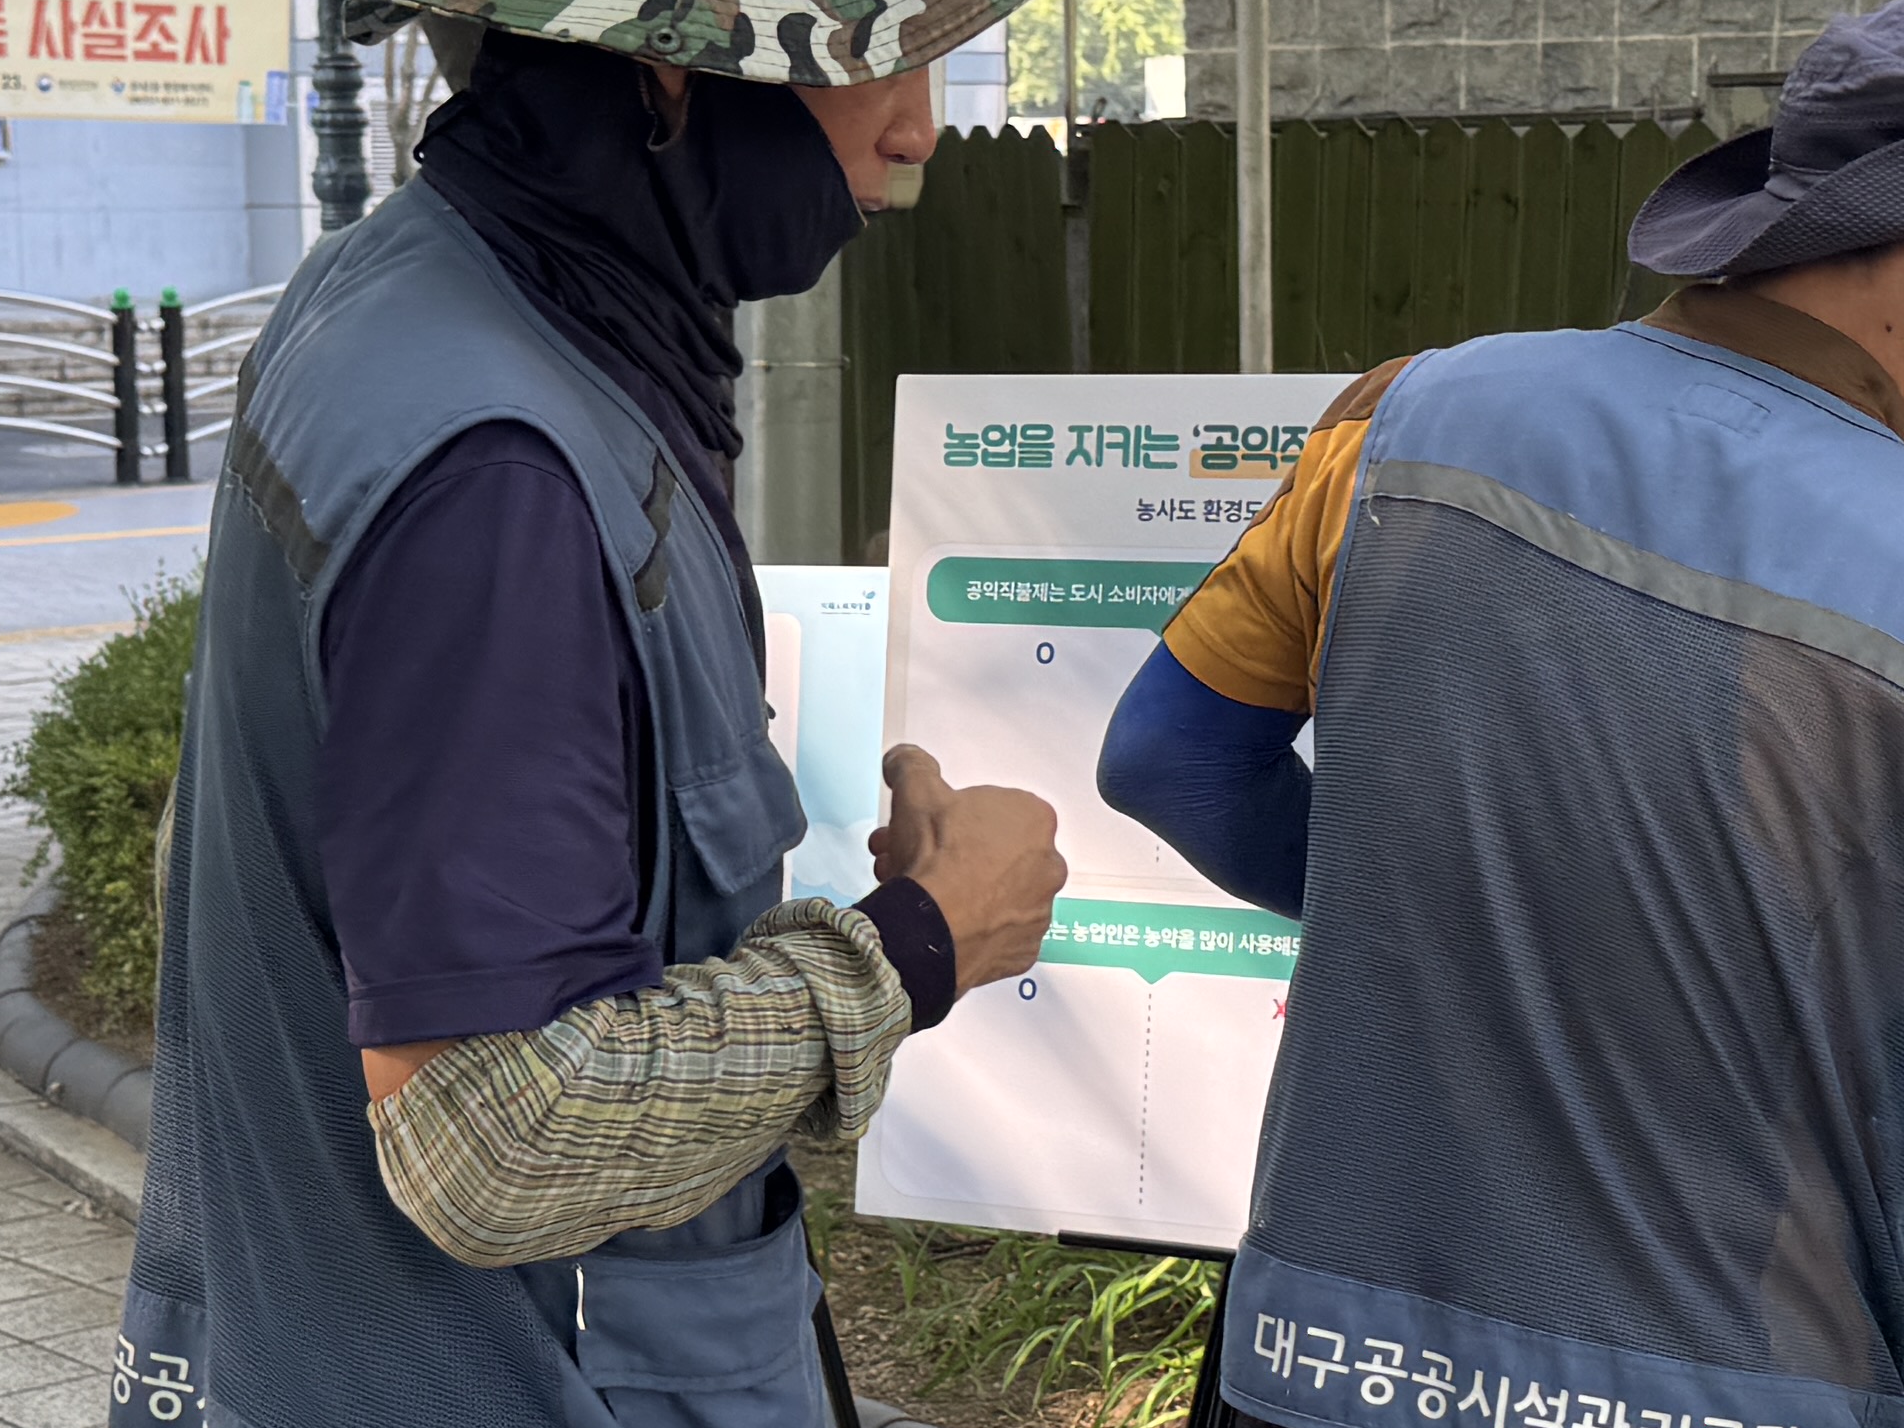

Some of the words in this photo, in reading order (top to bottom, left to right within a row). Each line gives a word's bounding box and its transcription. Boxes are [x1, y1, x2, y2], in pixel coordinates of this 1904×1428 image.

[943, 422, 1056, 469] 농업을
[1065, 424, 1180, 470] 지키는
[1135, 498, 1197, 523] 농사도
[966, 580, 1066, 604] 공익직불제는
[1068, 582, 1104, 605] 도시
[1072, 921, 1141, 947] 농업인은
[1143, 925, 1195, 952] 농약을
[1199, 930, 1235, 954] 많이
